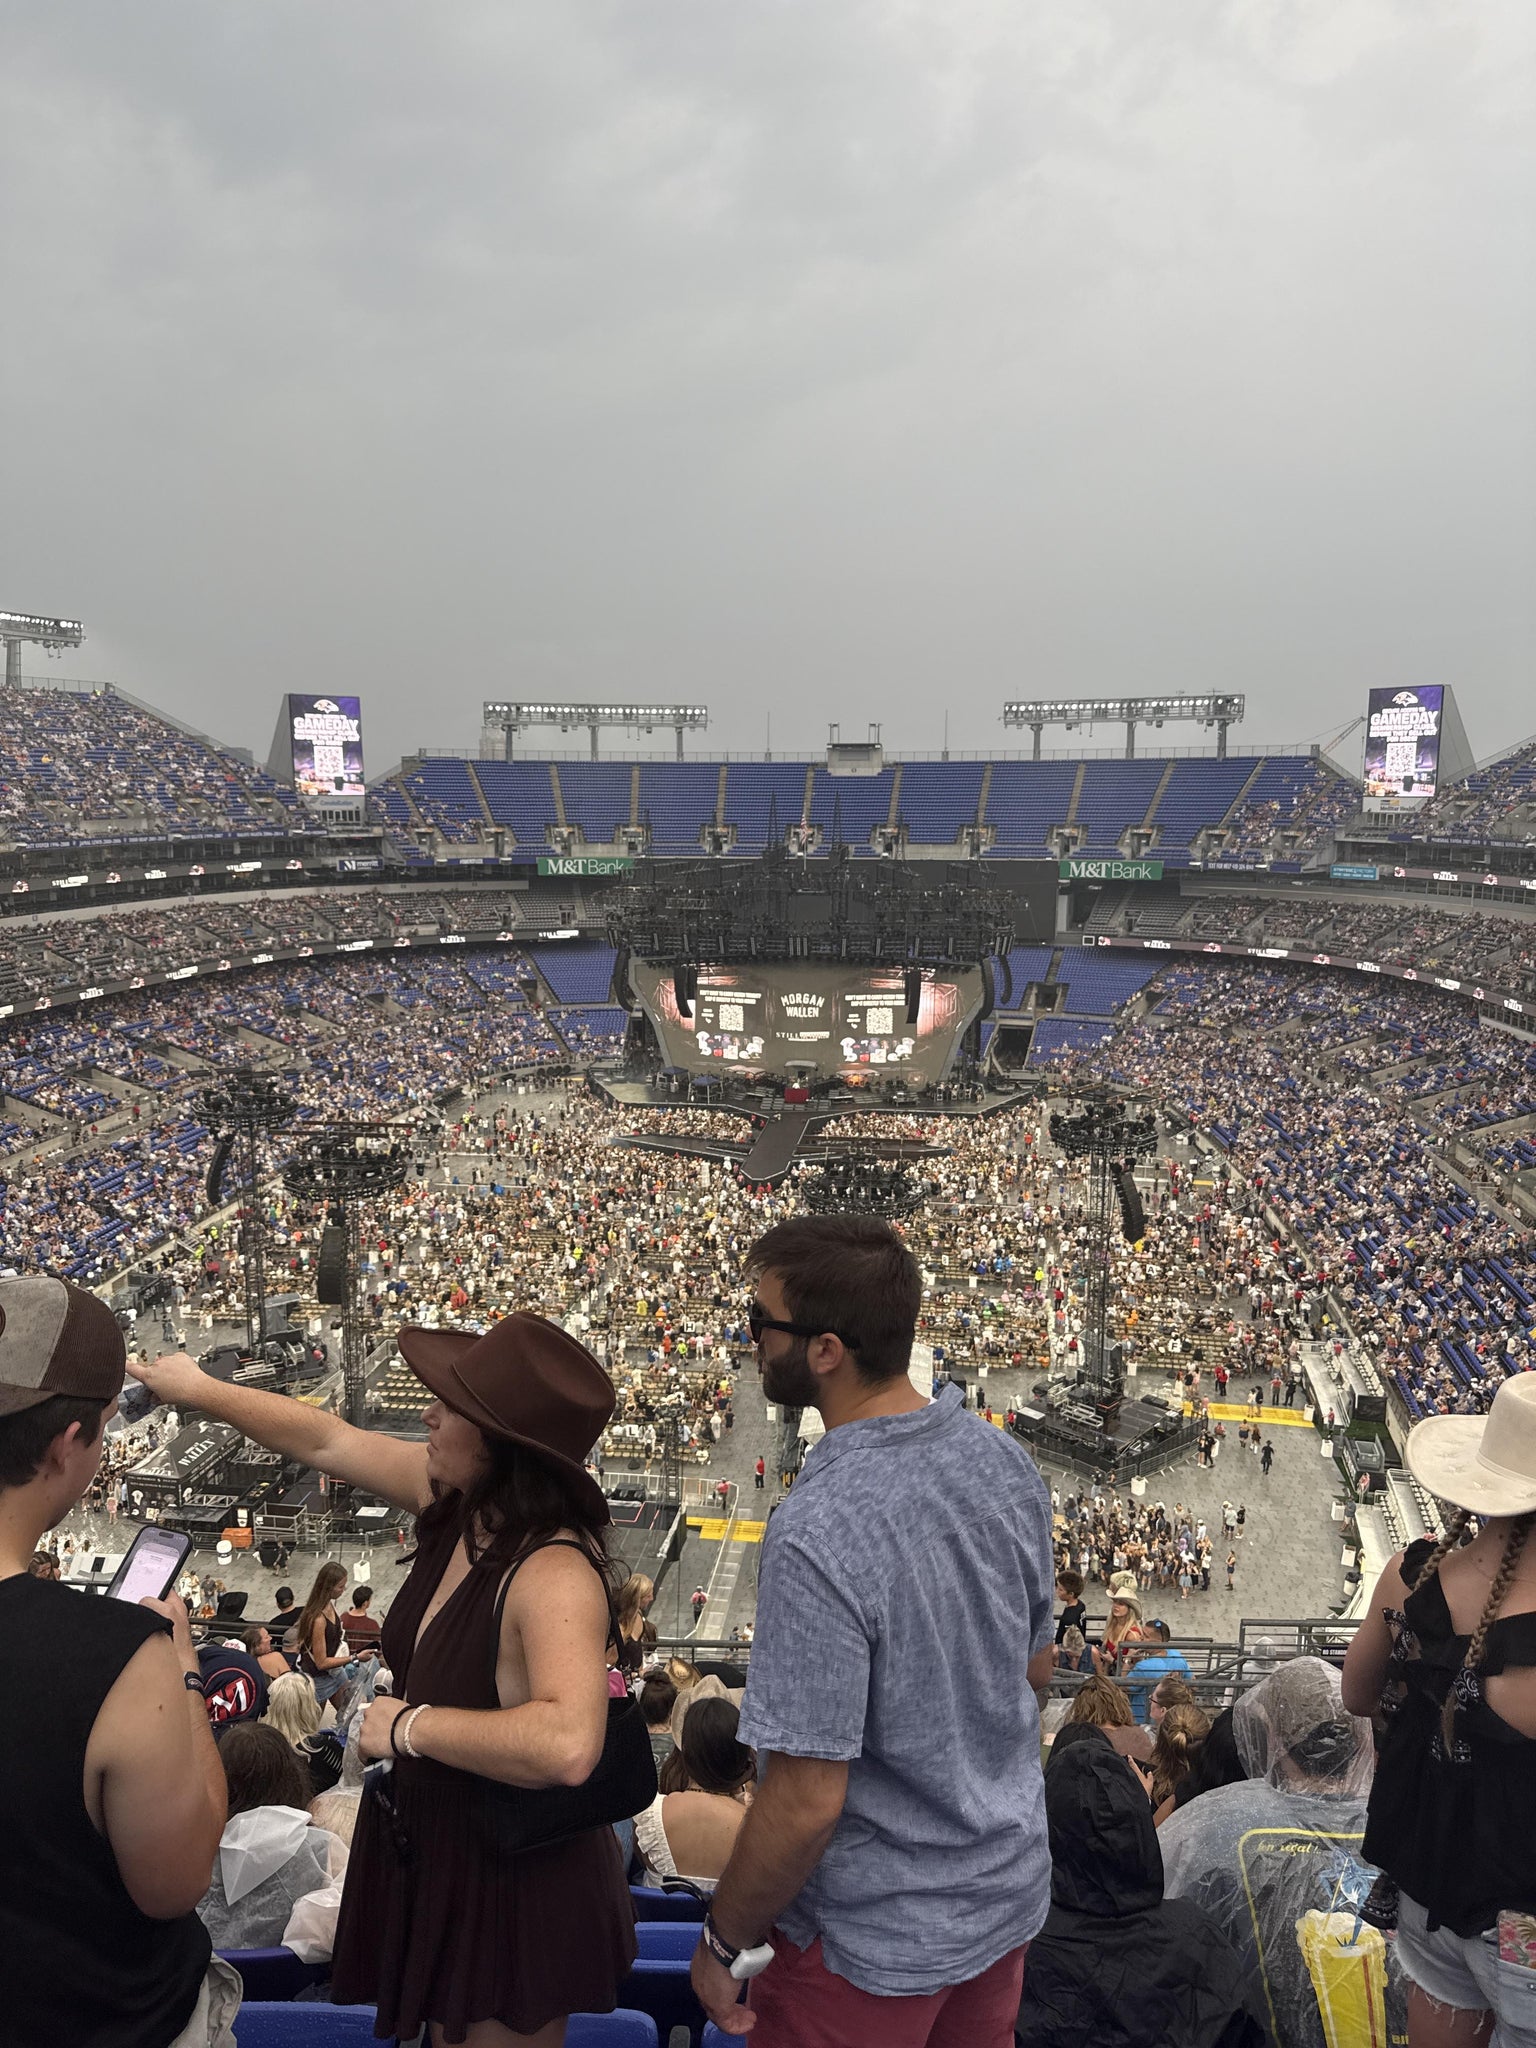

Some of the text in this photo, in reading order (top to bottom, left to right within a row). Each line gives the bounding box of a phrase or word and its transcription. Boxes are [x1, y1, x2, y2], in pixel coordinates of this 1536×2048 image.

[293, 716, 359, 731] GAMEDAY
[1370, 711, 1439, 726] GAMEDAY
[547, 859, 624, 875] M&T Bank
[1069, 862, 1152, 879] M&T Bank
[780, 992, 825, 1008] MORGAN
[785, 1006, 820, 1018] WALLEN
[775, 1031, 800, 1039] STILL
[1147, 1266, 1155, 1274] A
[686, 1323, 694, 1331] H
[1171, 1342, 1178, 1350] F
[629, 1426, 636, 1435] L
[178, 1438, 216, 1466] WALLEN
[208, 1679, 249, 1722] M
